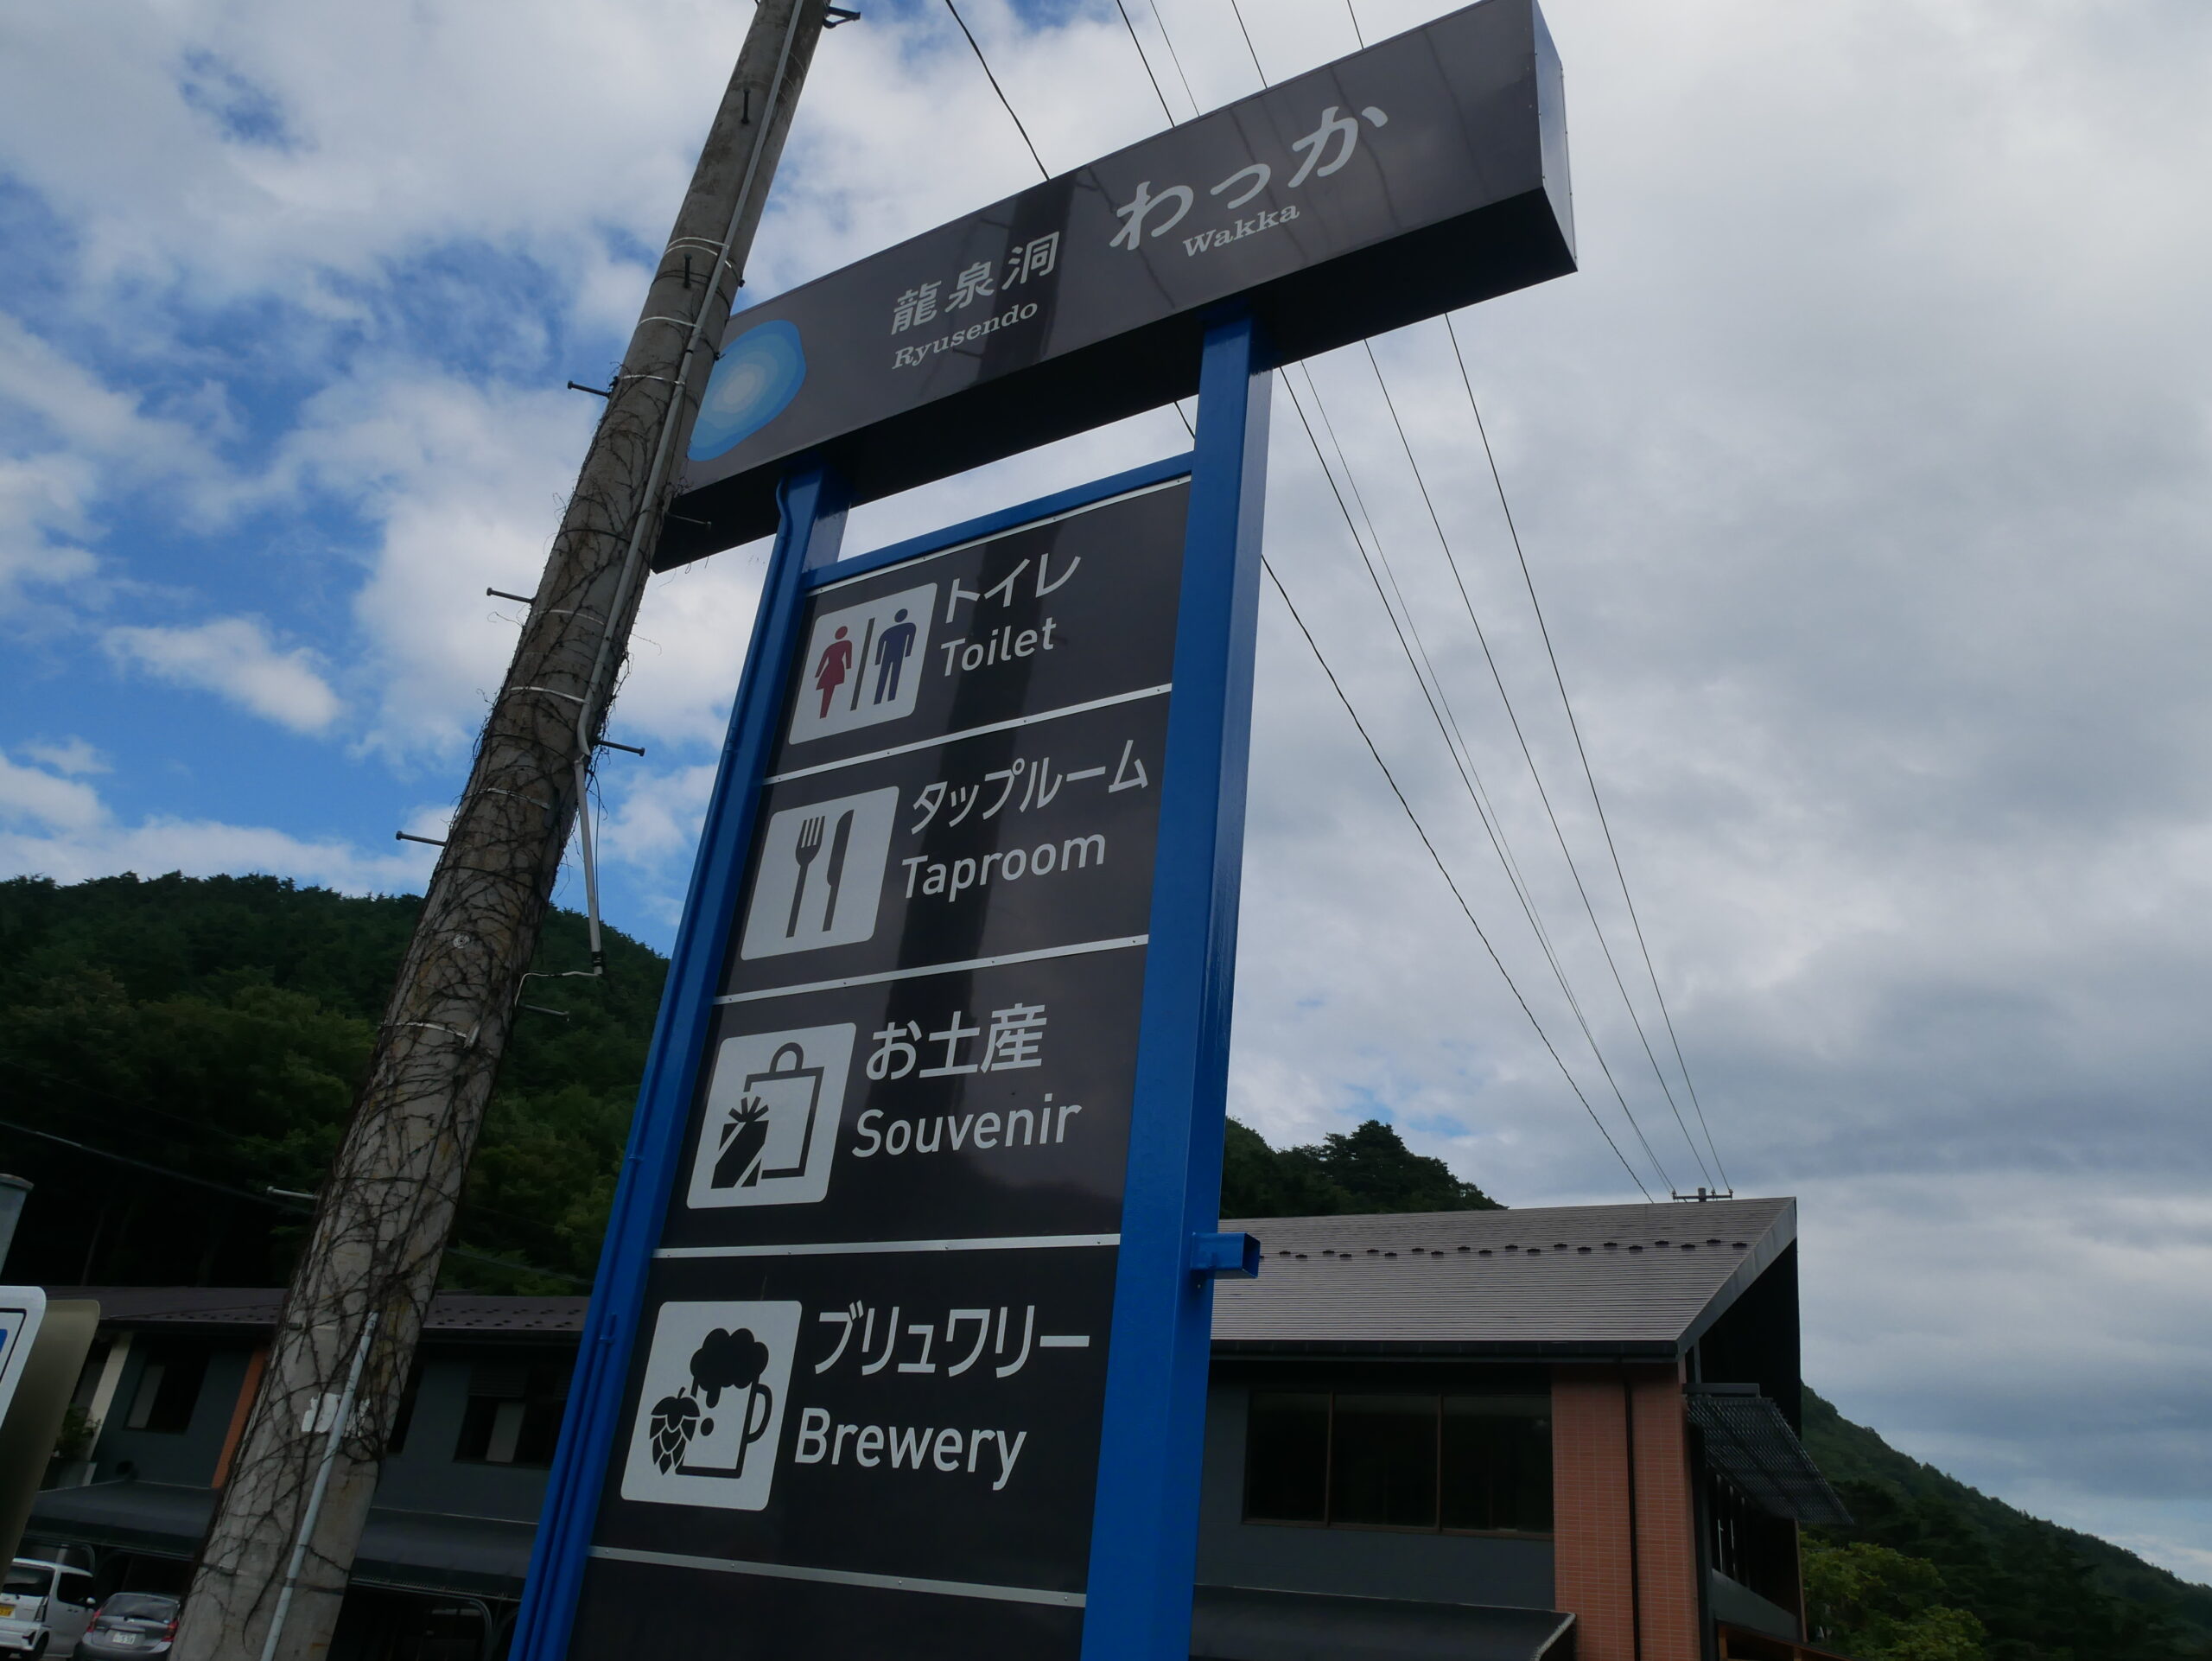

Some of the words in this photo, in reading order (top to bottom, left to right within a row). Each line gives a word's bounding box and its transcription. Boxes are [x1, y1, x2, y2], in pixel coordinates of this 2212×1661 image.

[1109, 105, 1389, 251] わっか
[1182, 205, 1300, 257] Wakka
[892, 231, 1059, 335] 龍泉洞
[892, 302, 1038, 370] Ryusendo
[945, 553, 1081, 624] トイレ
[941, 617, 1057, 677] Toilet
[912, 740, 1148, 835] タップルーム
[902, 834, 1106, 902] Taproom
[866, 1002, 1047, 1080] お土産
[851, 1093, 1083, 1158] Souvenir
[815, 1300, 1090, 1378] ブリュワリー
[795, 1407, 1027, 1491] Brewery
